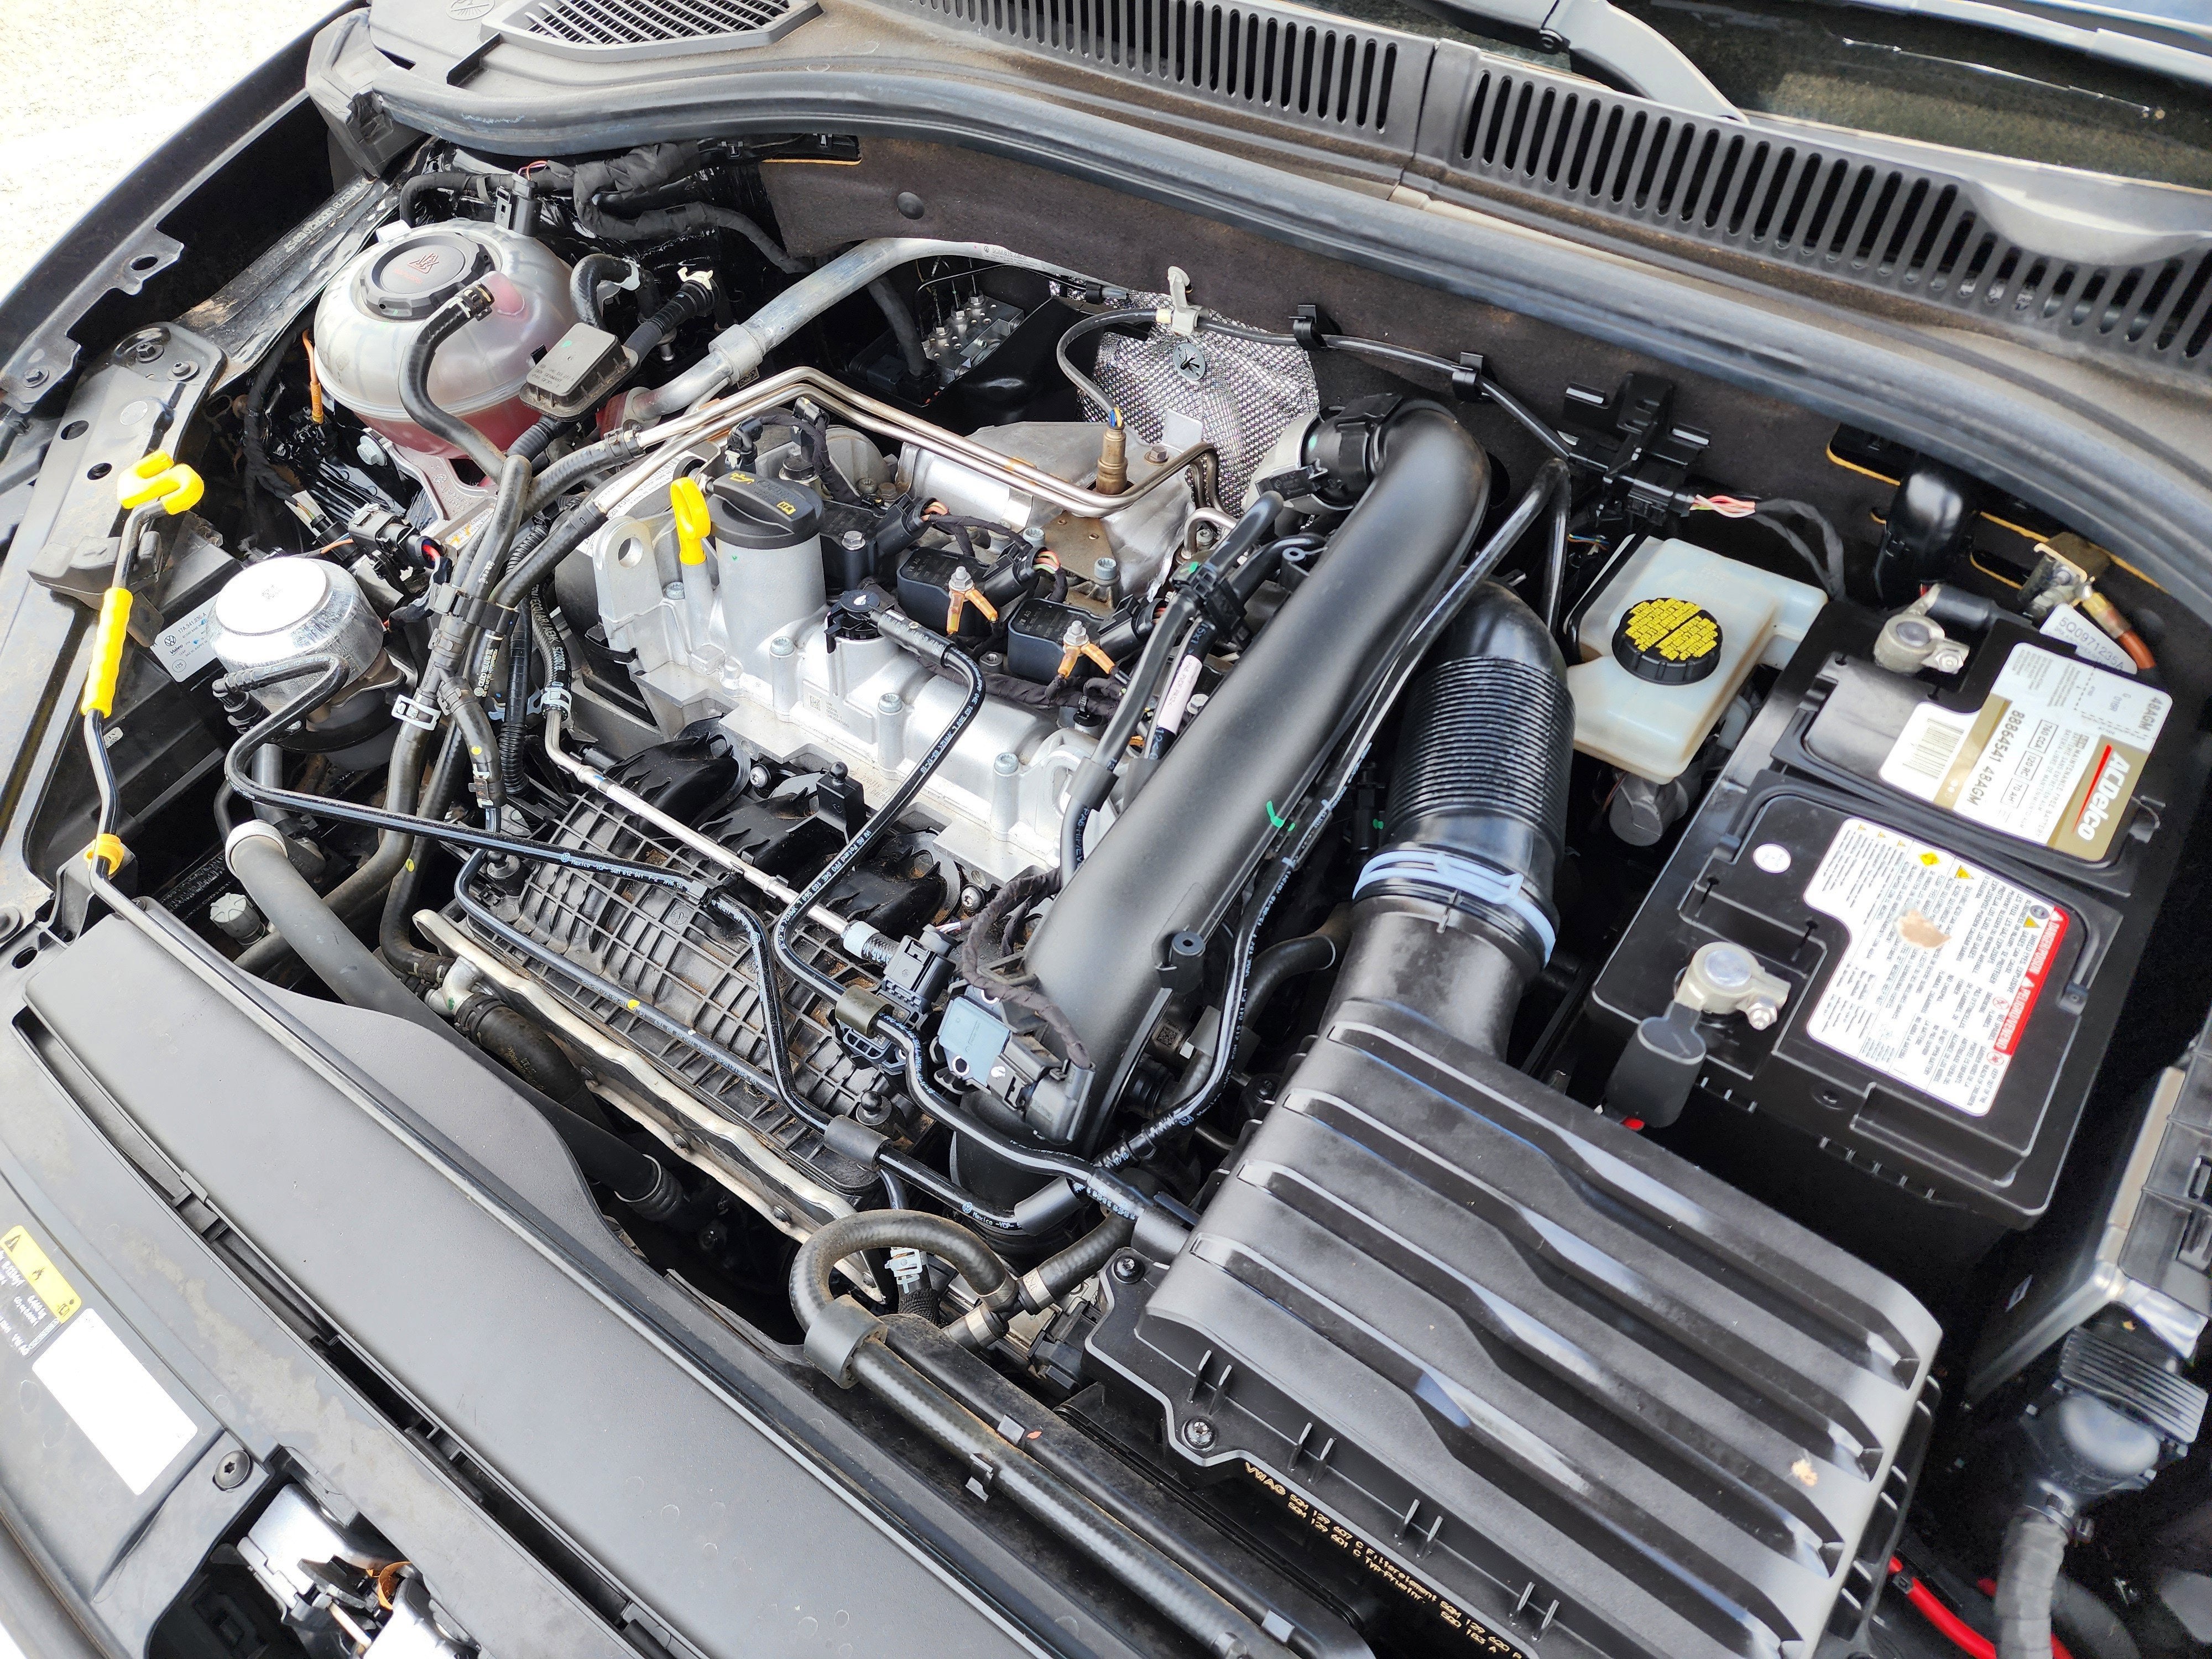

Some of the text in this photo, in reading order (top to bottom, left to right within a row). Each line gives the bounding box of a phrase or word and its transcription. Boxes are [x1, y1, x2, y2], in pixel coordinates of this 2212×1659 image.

[2136, 695, 2165, 733] 48AGM
[2033, 735, 2046, 750] CCA
[1965, 708, 2026, 807] 88864541 48AGM
[2019, 754, 2037, 778] 120 RC
[2012, 781, 2023, 793] 70
[2032, 748, 2082, 839] MAINTENANCE FREE BATTERY
[2077, 751, 2131, 841] ACDelco
[839, 842, 859, 863] Poland
[571, 859, 591, 869] Mexico
[820, 869, 832, 881] 04E
[811, 879, 822, 891] 103
[800, 888, 813, 902] 560
[2015, 893, 2023, 903] LES
[1987, 906, 1996, 917] LOS
[2016, 929, 2028, 948] GASES
[2024, 933, 2038, 952] SHIELD
[2028, 920, 2060, 975] DANGER/POISON
[2011, 947, 2021, 958] CAN
[2006, 965, 2023, 994] EXPLOSIVE
[1994, 985, 2031, 1051] PELIGRO/VENENO
[972, 1211, 993, 1226] Mexico
[1308, 1517, 1329, 1535] 129
[1350, 1547, 1363, 1559] C
[1310, 1509, 1332, 1527] 129
[1353, 1539, 1365, 1551] C
[1462, 1616, 1485, 1635] 129
